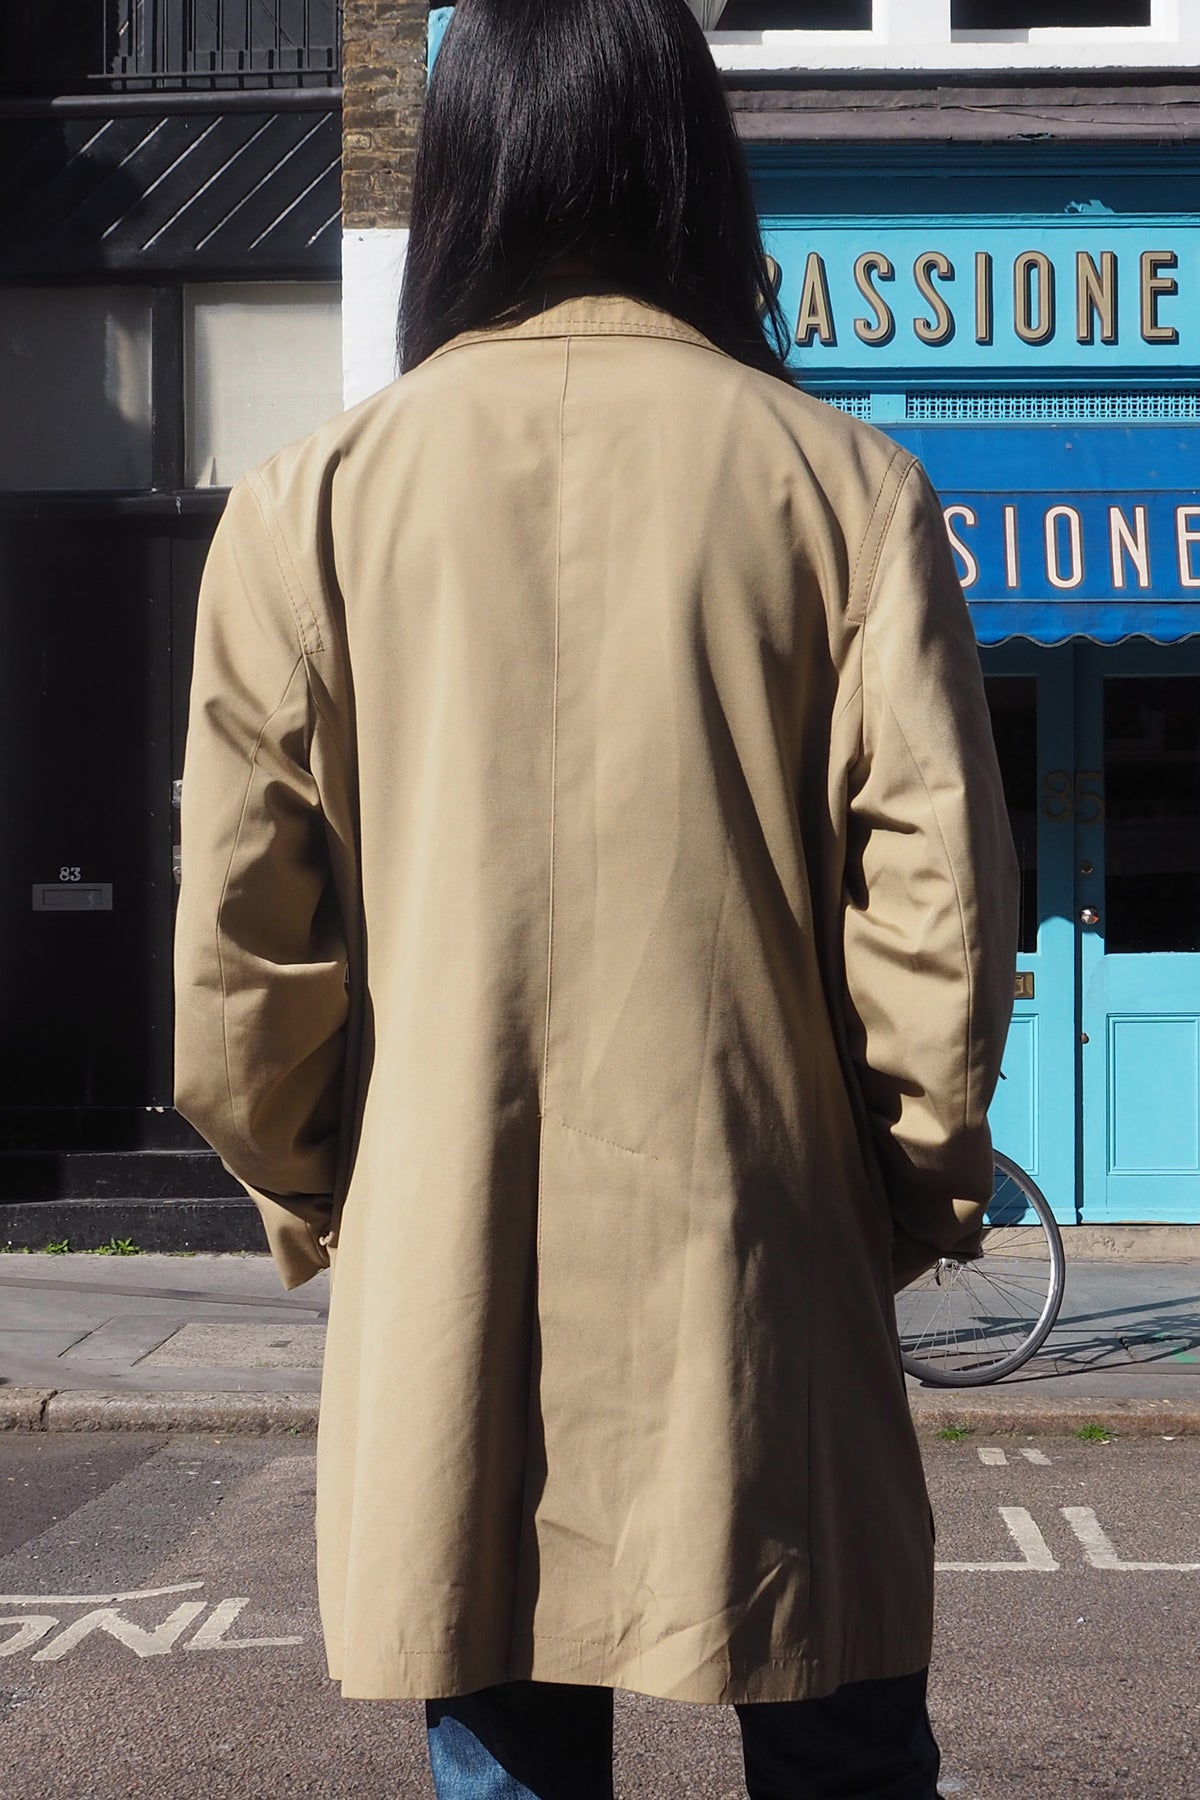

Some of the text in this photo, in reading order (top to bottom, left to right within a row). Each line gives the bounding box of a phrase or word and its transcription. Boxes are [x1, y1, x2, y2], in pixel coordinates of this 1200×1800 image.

[756, 251, 1181, 346] ASSIONE
[1042, 770, 1105, 825] 85
[59, 867, 81, 881] 83
